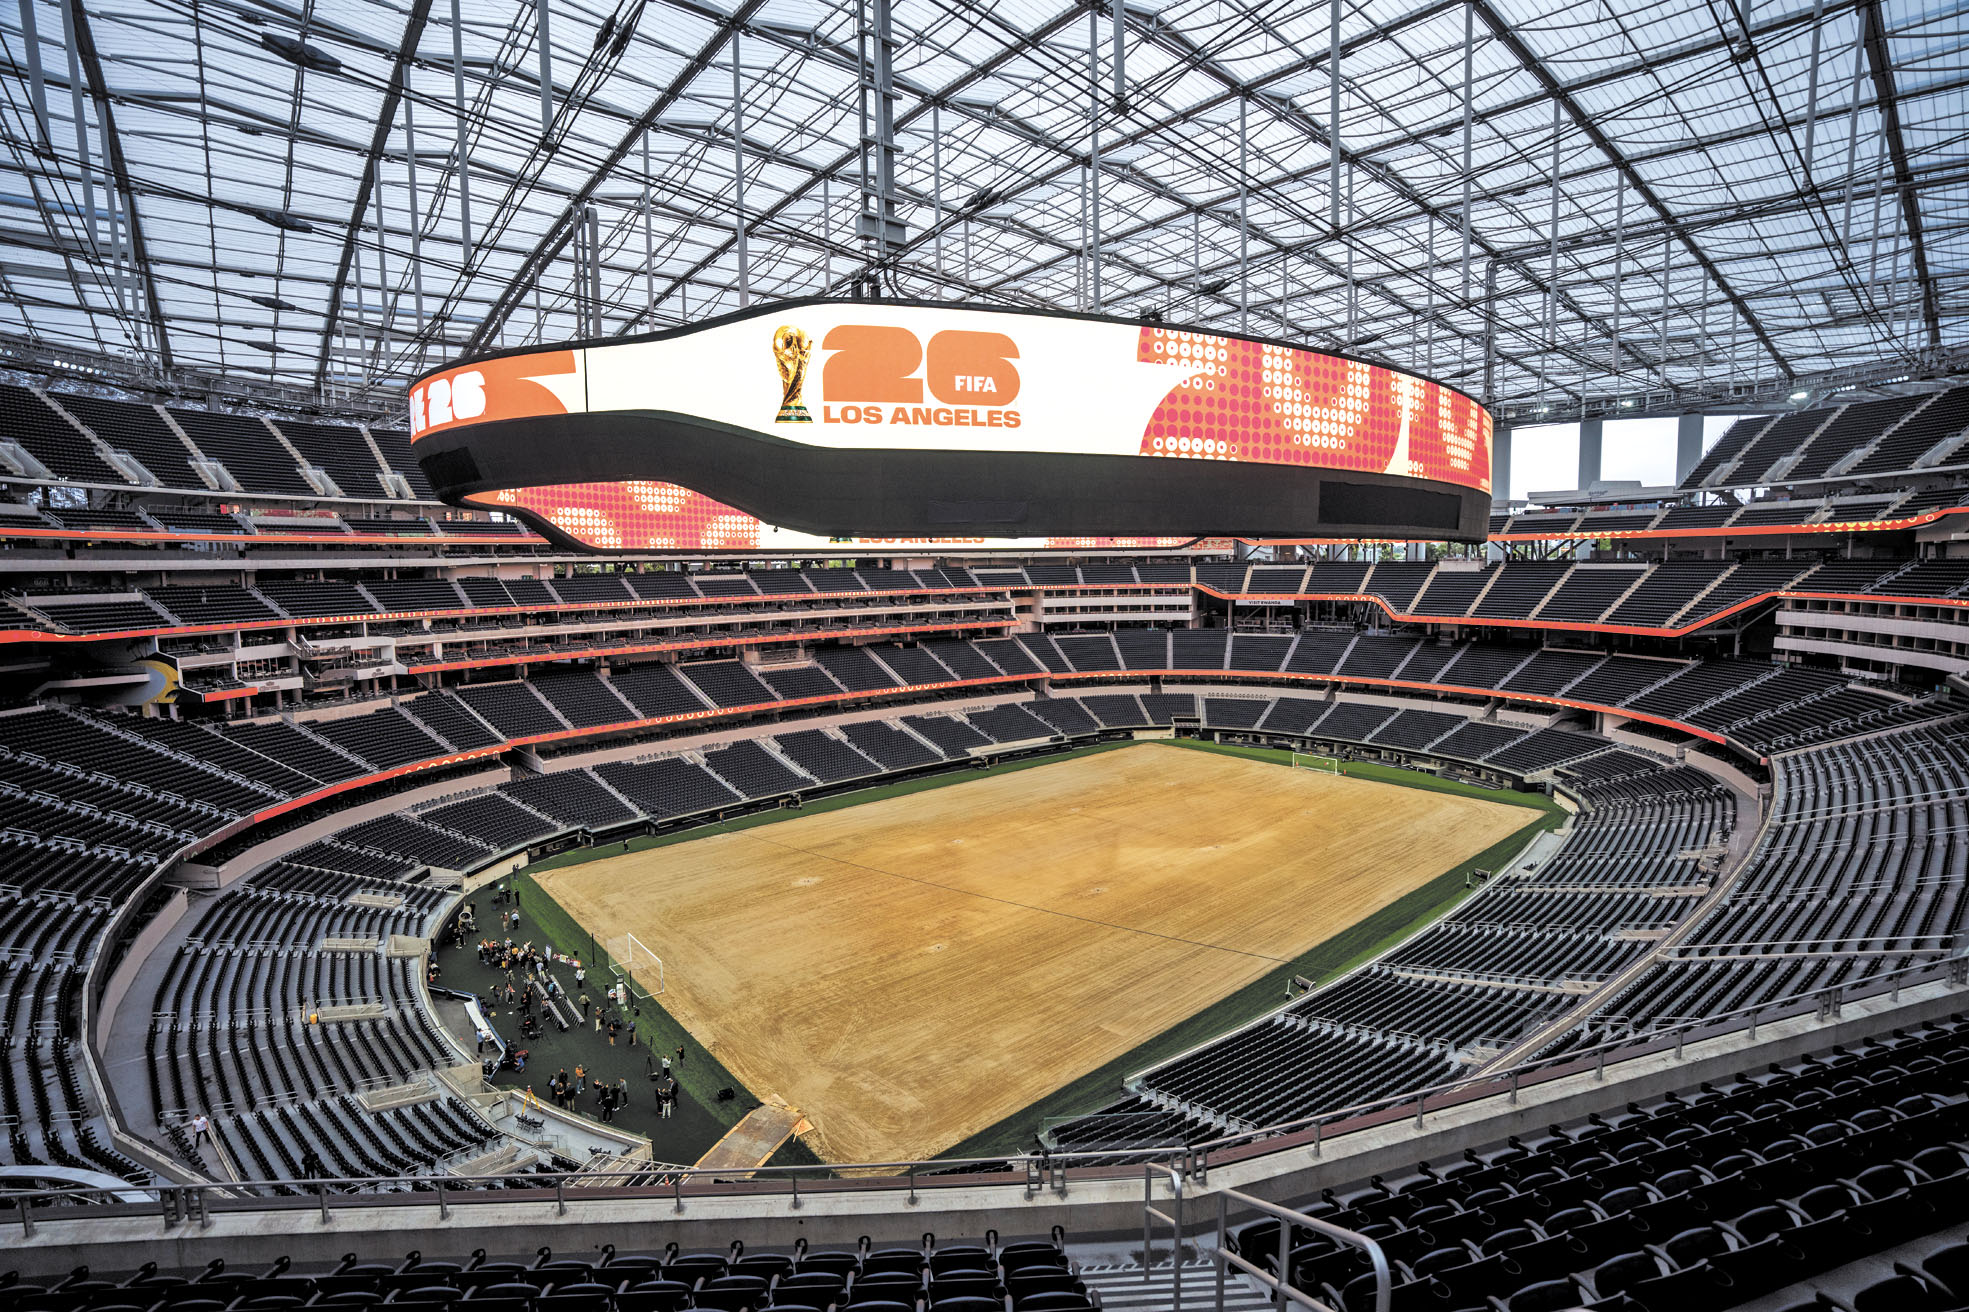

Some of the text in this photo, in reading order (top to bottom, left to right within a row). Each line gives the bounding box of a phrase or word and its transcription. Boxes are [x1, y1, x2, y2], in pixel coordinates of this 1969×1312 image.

[822, 324, 1020, 406] 26
[955, 375, 997, 393] FIFA
[427, 371, 486, 427] 26
[824, 405, 1021, 428] LOS ANGELES
